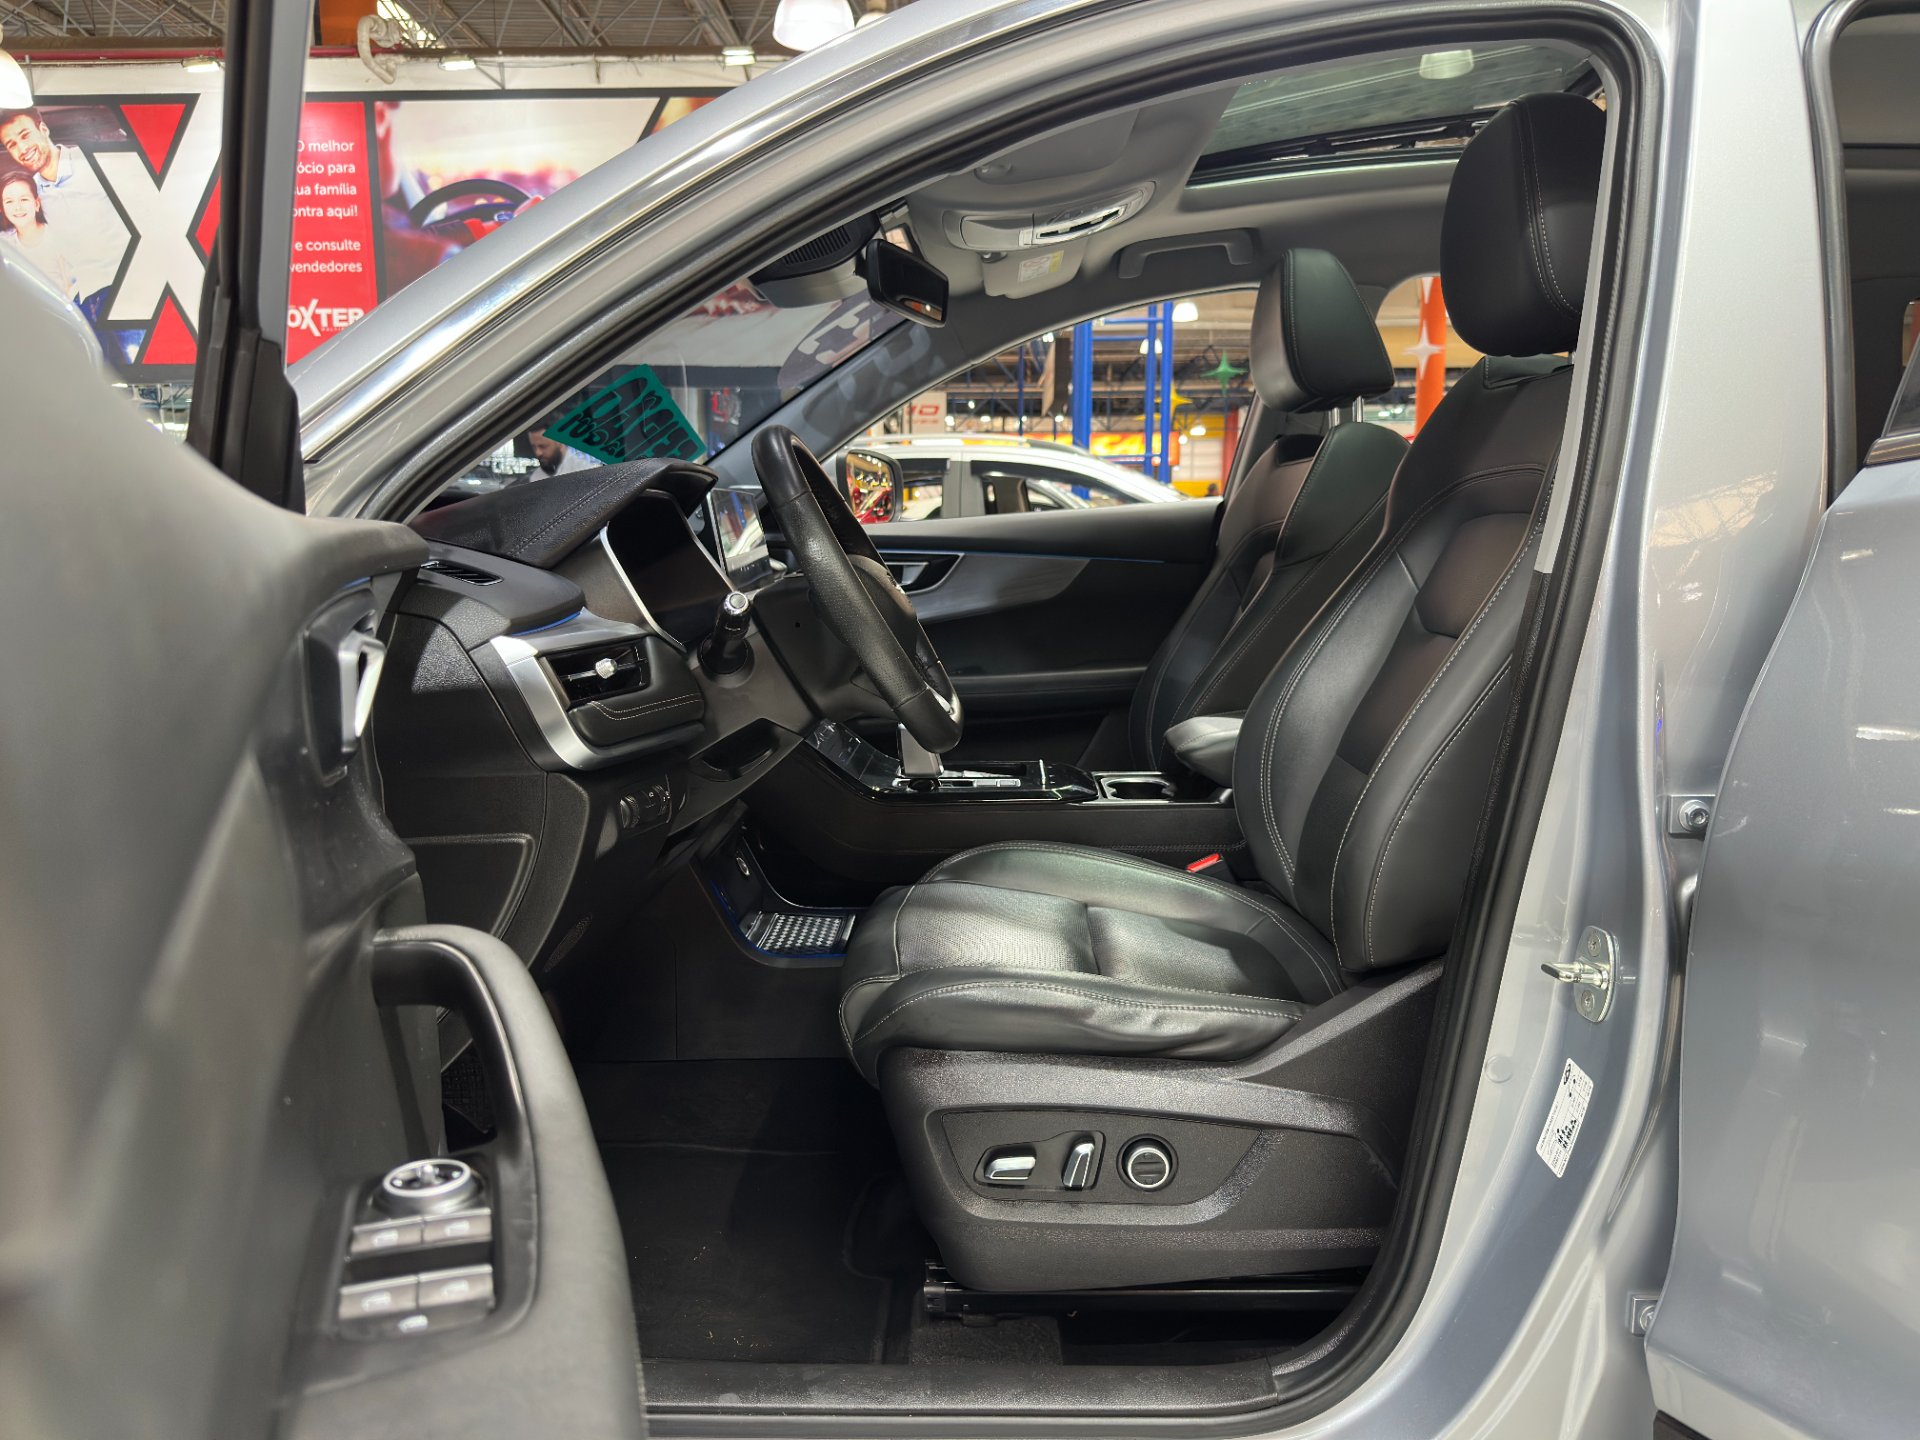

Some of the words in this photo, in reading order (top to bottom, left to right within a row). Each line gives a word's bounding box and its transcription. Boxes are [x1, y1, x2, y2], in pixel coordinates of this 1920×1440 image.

[308, 140, 354, 152] melhor
[297, 162, 325, 174] ócio
[327, 164, 356, 176] para
[294, 185, 312, 196] ua
[314, 182, 357, 196] família
[327, 204, 358, 219] aqui!
[295, 242, 303, 252] e
[306, 239, 361, 251] consulte
[290, 261, 363, 273] vendedores
